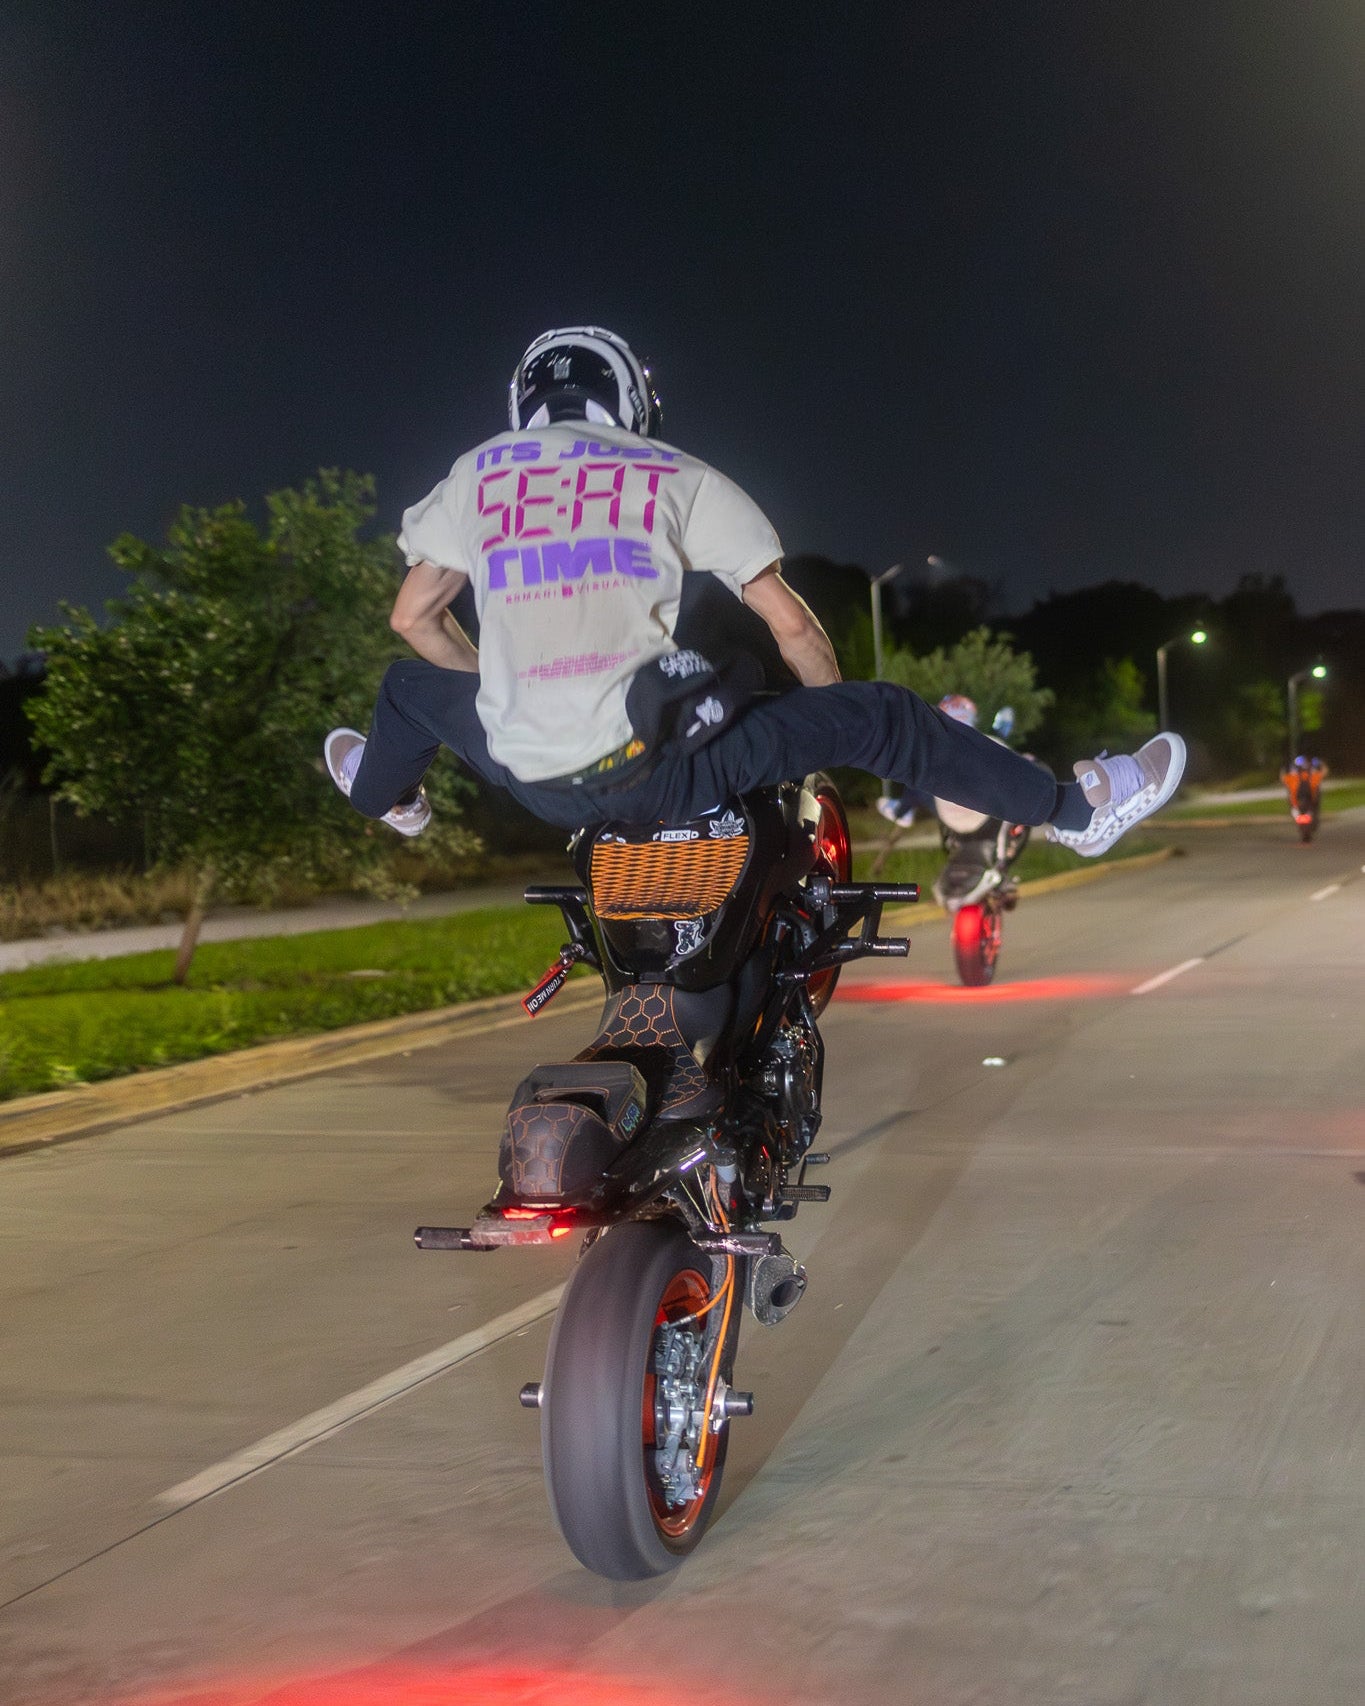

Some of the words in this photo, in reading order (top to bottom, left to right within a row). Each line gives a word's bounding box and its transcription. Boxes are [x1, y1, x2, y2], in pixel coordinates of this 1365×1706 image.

[477, 441, 542, 472] ITS
[559, 440, 683, 462] JUST
[487, 537, 660, 591] TIME
[536, 990, 547, 1003] ME
[546, 976, 562, 996] TURN
